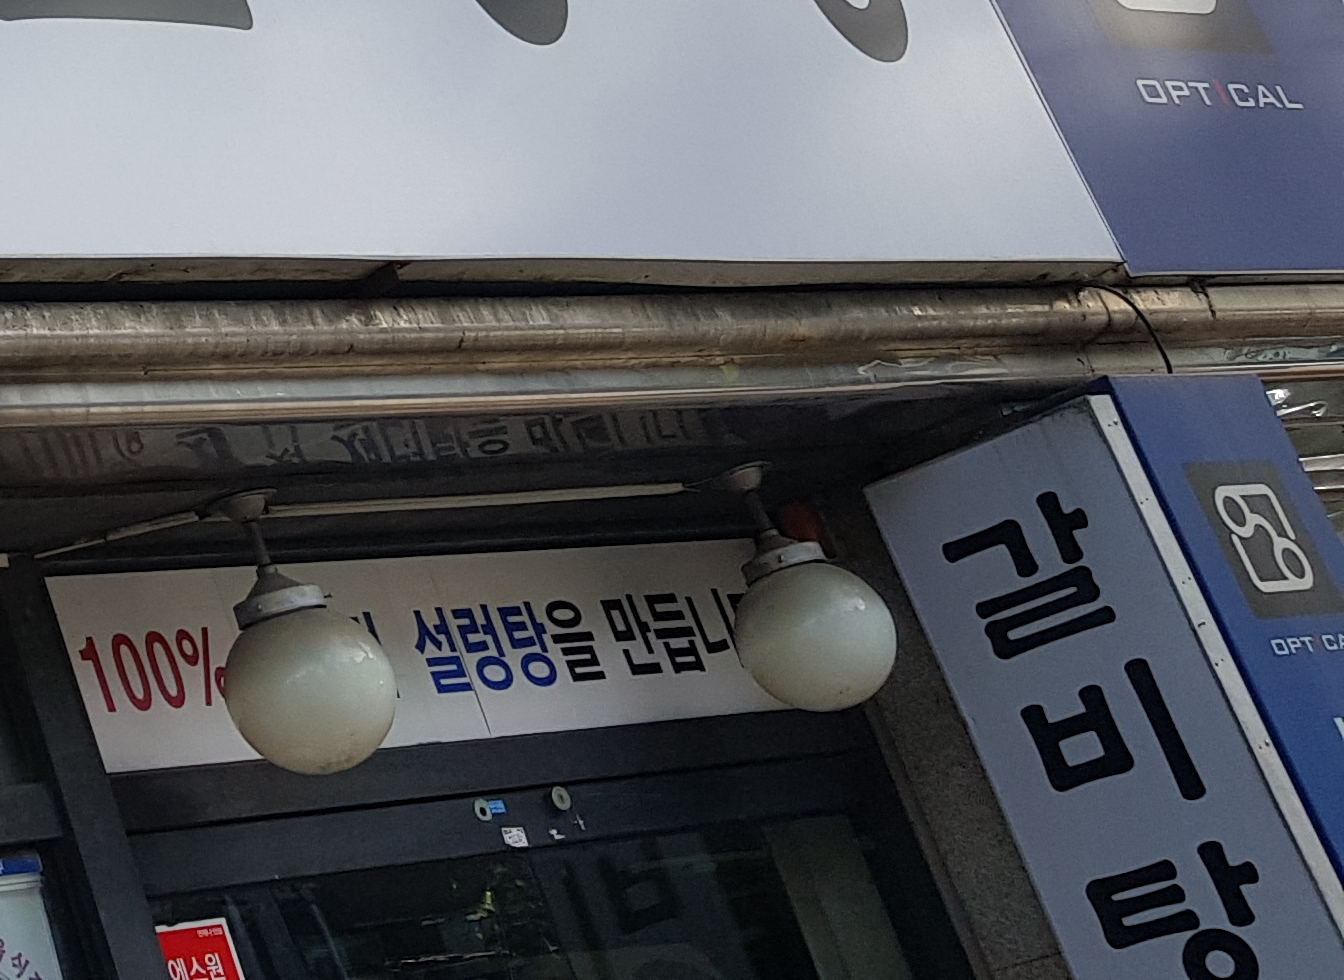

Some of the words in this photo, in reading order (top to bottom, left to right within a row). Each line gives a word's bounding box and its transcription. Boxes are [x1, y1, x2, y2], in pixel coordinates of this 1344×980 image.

[1136, 78, 1305, 110] OPTICAL
[78, 626, 226, 713] 100%
[412, 599, 606, 695] 설렁탕을
[600, 588, 746, 676] 만듭니
[942, 491, 1260, 980] 갈비탕
